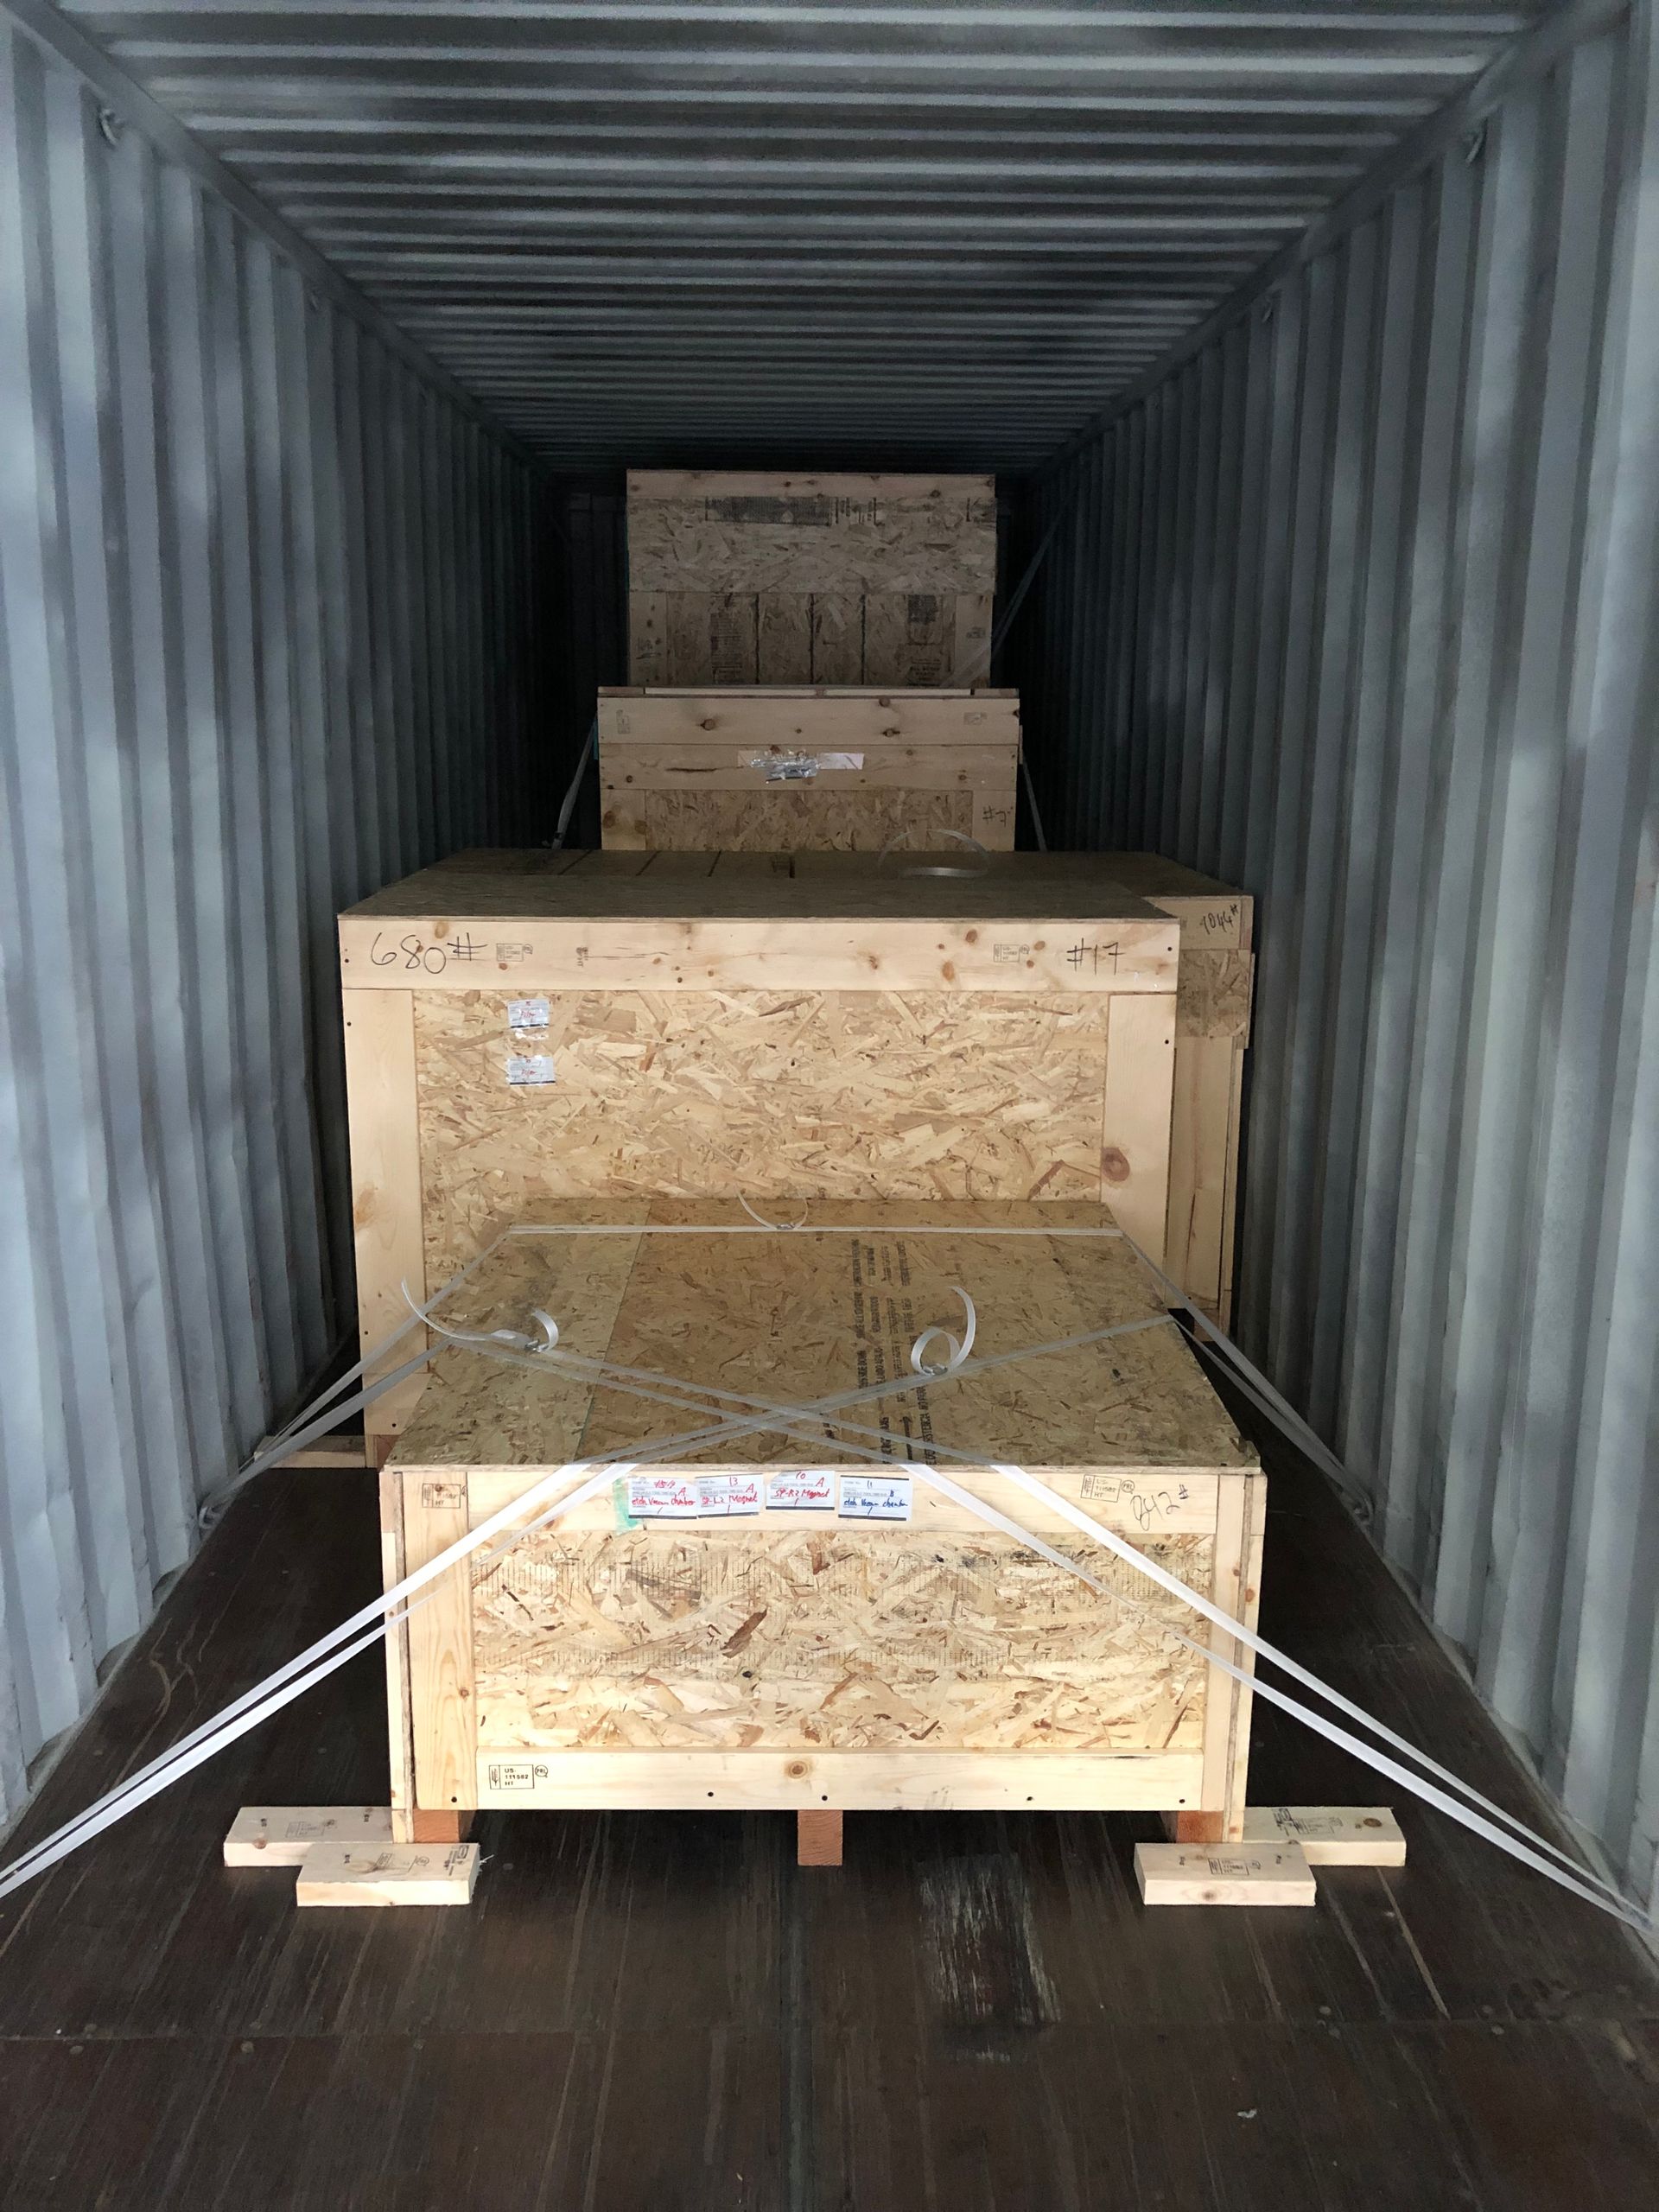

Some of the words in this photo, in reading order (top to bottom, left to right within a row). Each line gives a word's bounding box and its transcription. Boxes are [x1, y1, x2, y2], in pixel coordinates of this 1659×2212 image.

[371, 931, 488, 974] 680#
[1066, 938, 1125, 976] #17
[729, 1476, 739, 1487] 13
[815, 1477, 825, 1487] A
[678, 1486, 687, 1496] A
[745, 1483, 754, 1494] A
